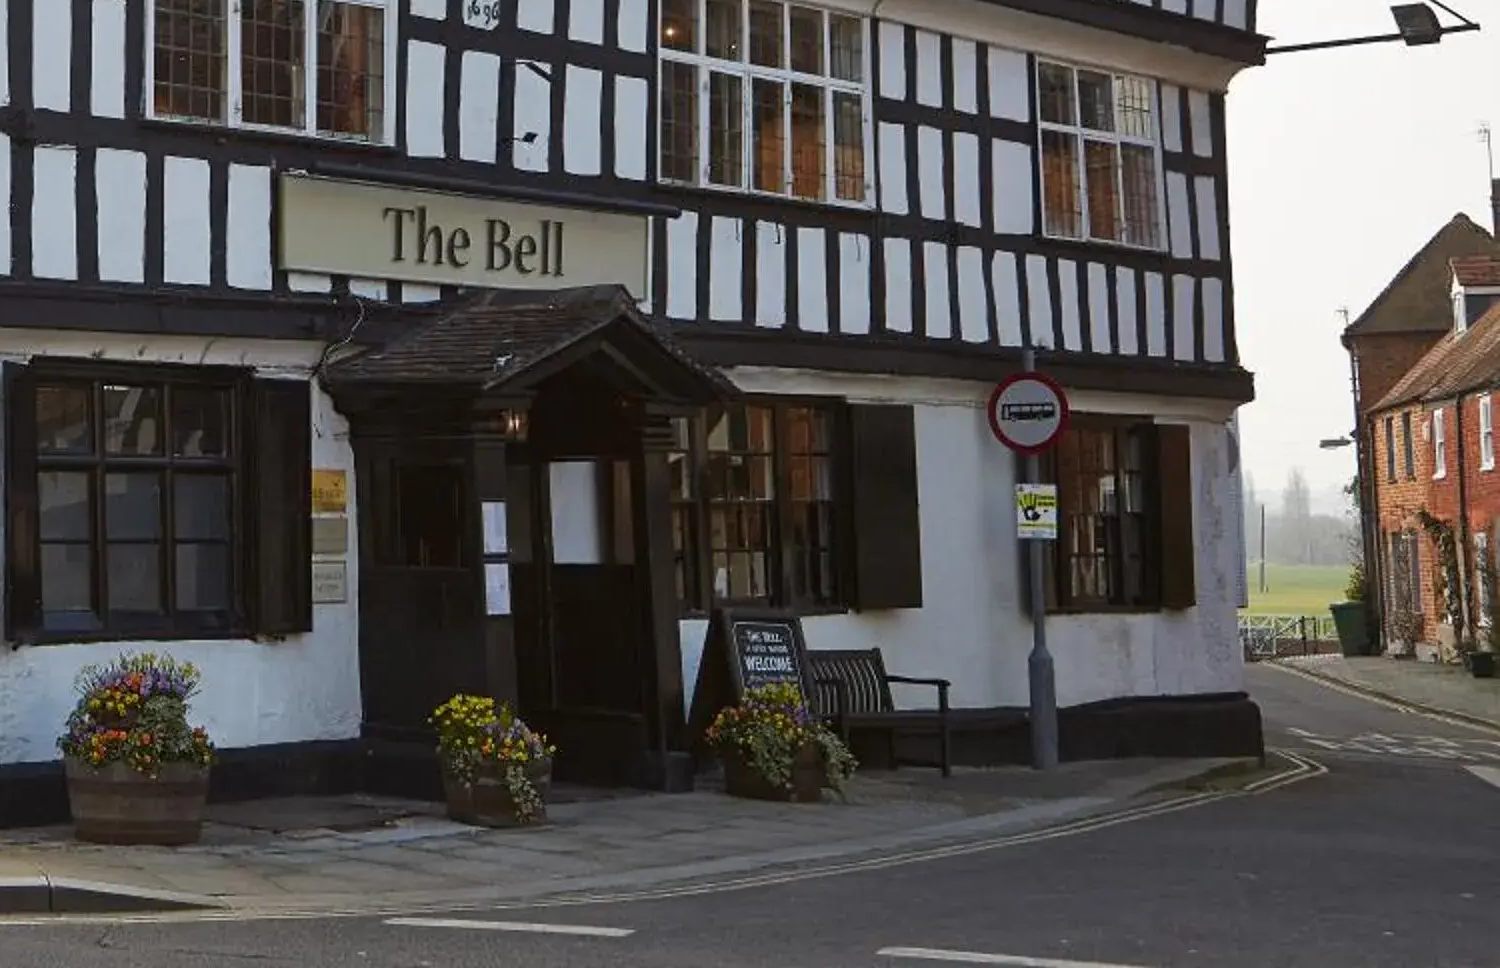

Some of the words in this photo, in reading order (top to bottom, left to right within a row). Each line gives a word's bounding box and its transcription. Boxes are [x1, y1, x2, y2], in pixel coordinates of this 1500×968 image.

[383, 204, 471, 270] The
[484, 217, 565, 279] Bell
[743, 655, 794, 672] WELCOME
